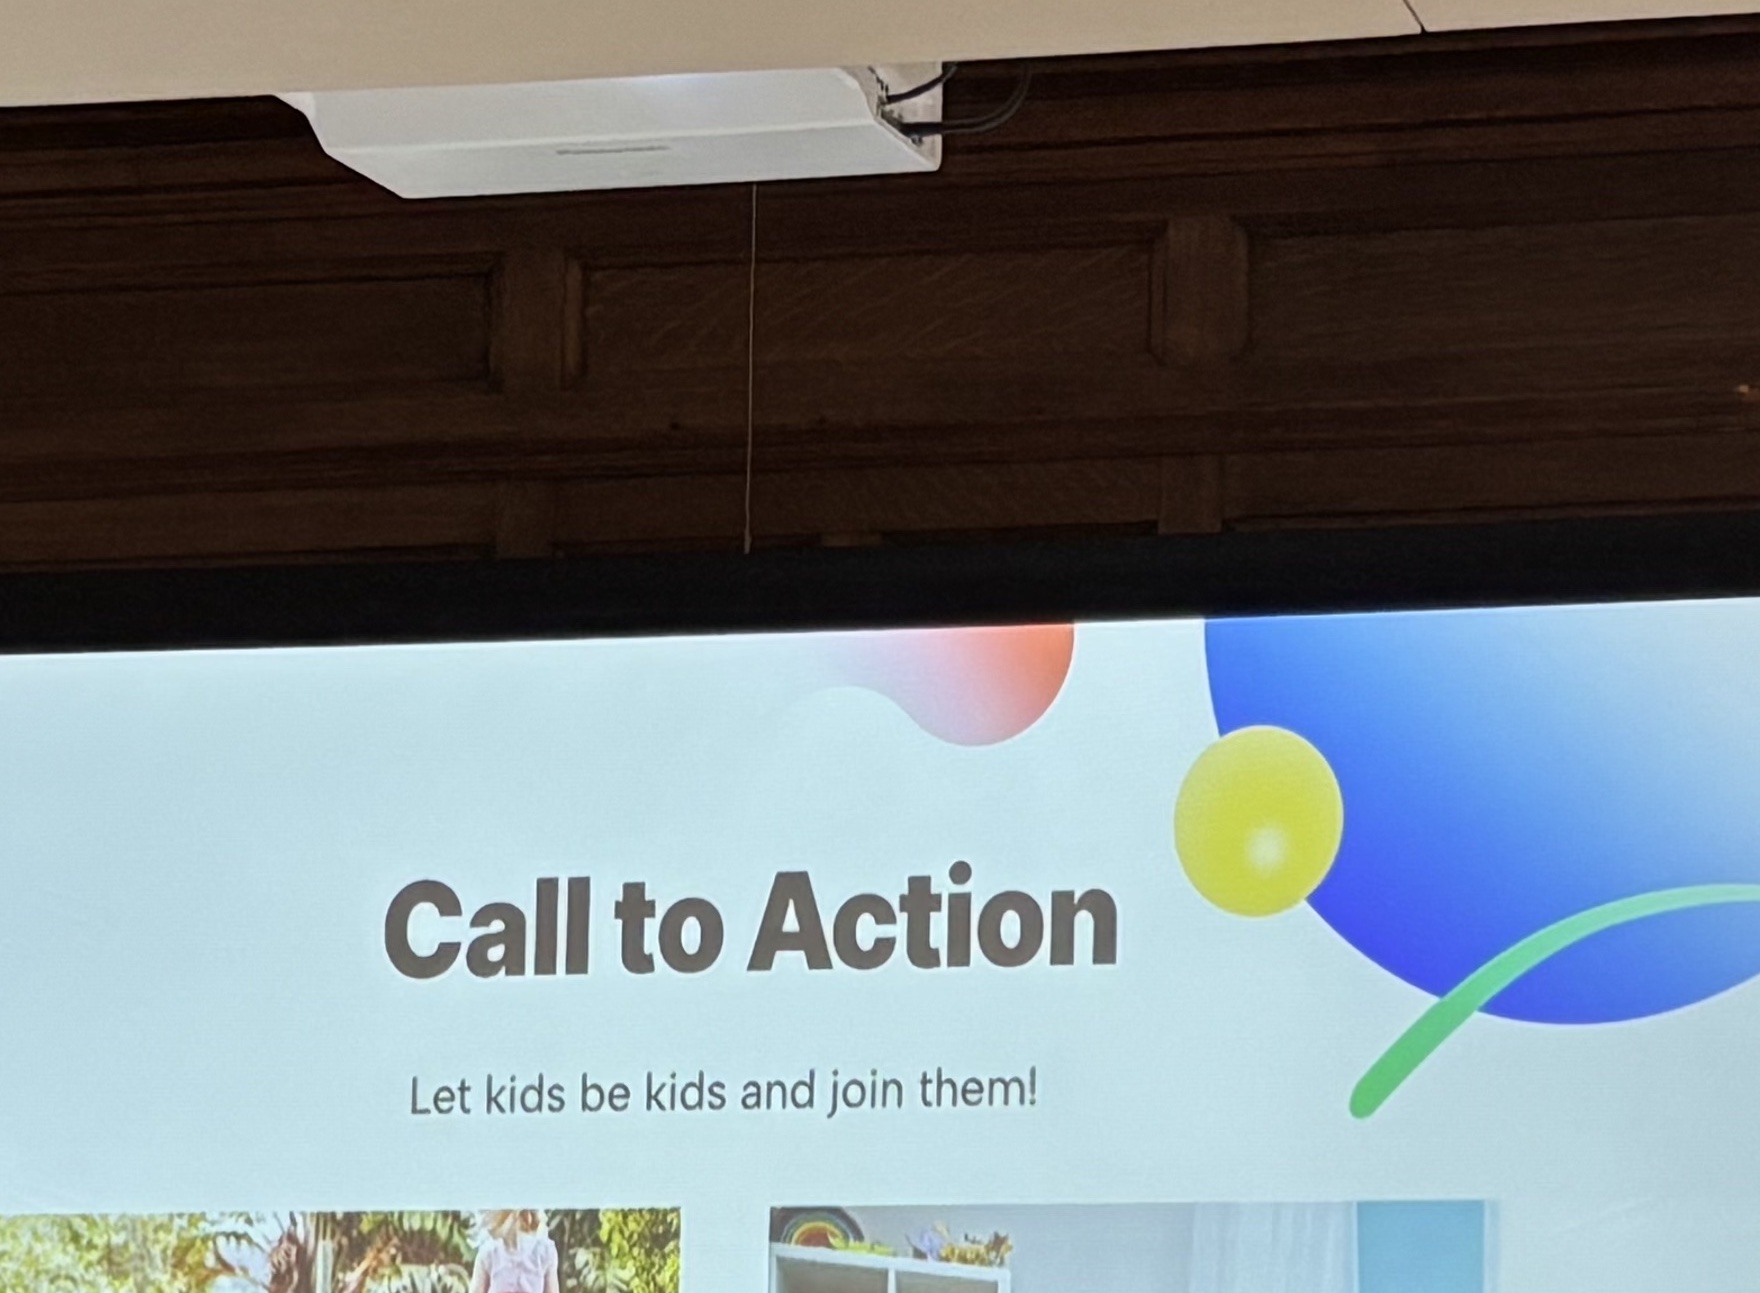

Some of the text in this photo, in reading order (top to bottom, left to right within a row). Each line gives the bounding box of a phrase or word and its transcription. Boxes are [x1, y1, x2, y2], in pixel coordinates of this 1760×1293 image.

[384, 860, 1118, 979] Call to Action
[410, 1066, 1038, 1119] Let kids be kids and join them!
